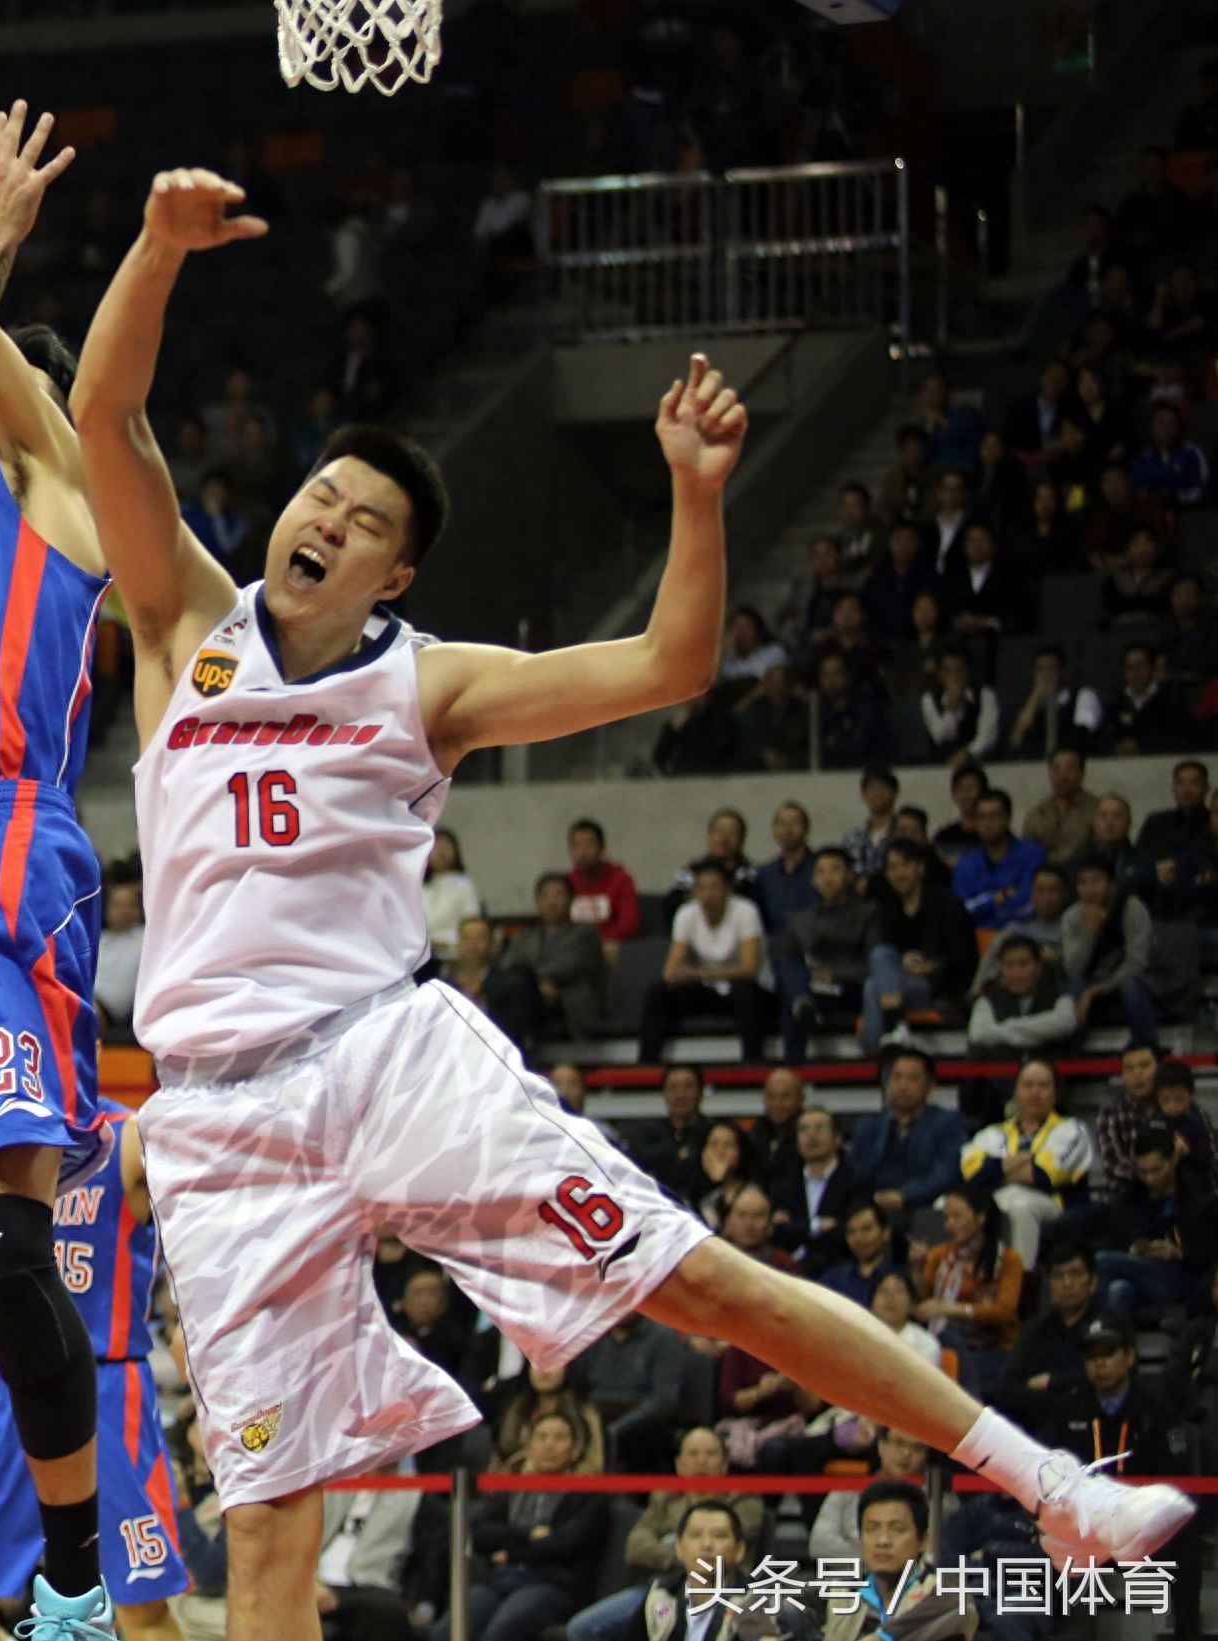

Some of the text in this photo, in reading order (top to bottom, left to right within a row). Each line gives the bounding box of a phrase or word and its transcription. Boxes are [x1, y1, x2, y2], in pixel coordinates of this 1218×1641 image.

[194, 663, 232, 692] ups
[227, 769, 301, 848] 16
[537, 1174, 624, 1262] 16
[53, 1239, 94, 1294] 15
[119, 1513, 170, 1570] 15
